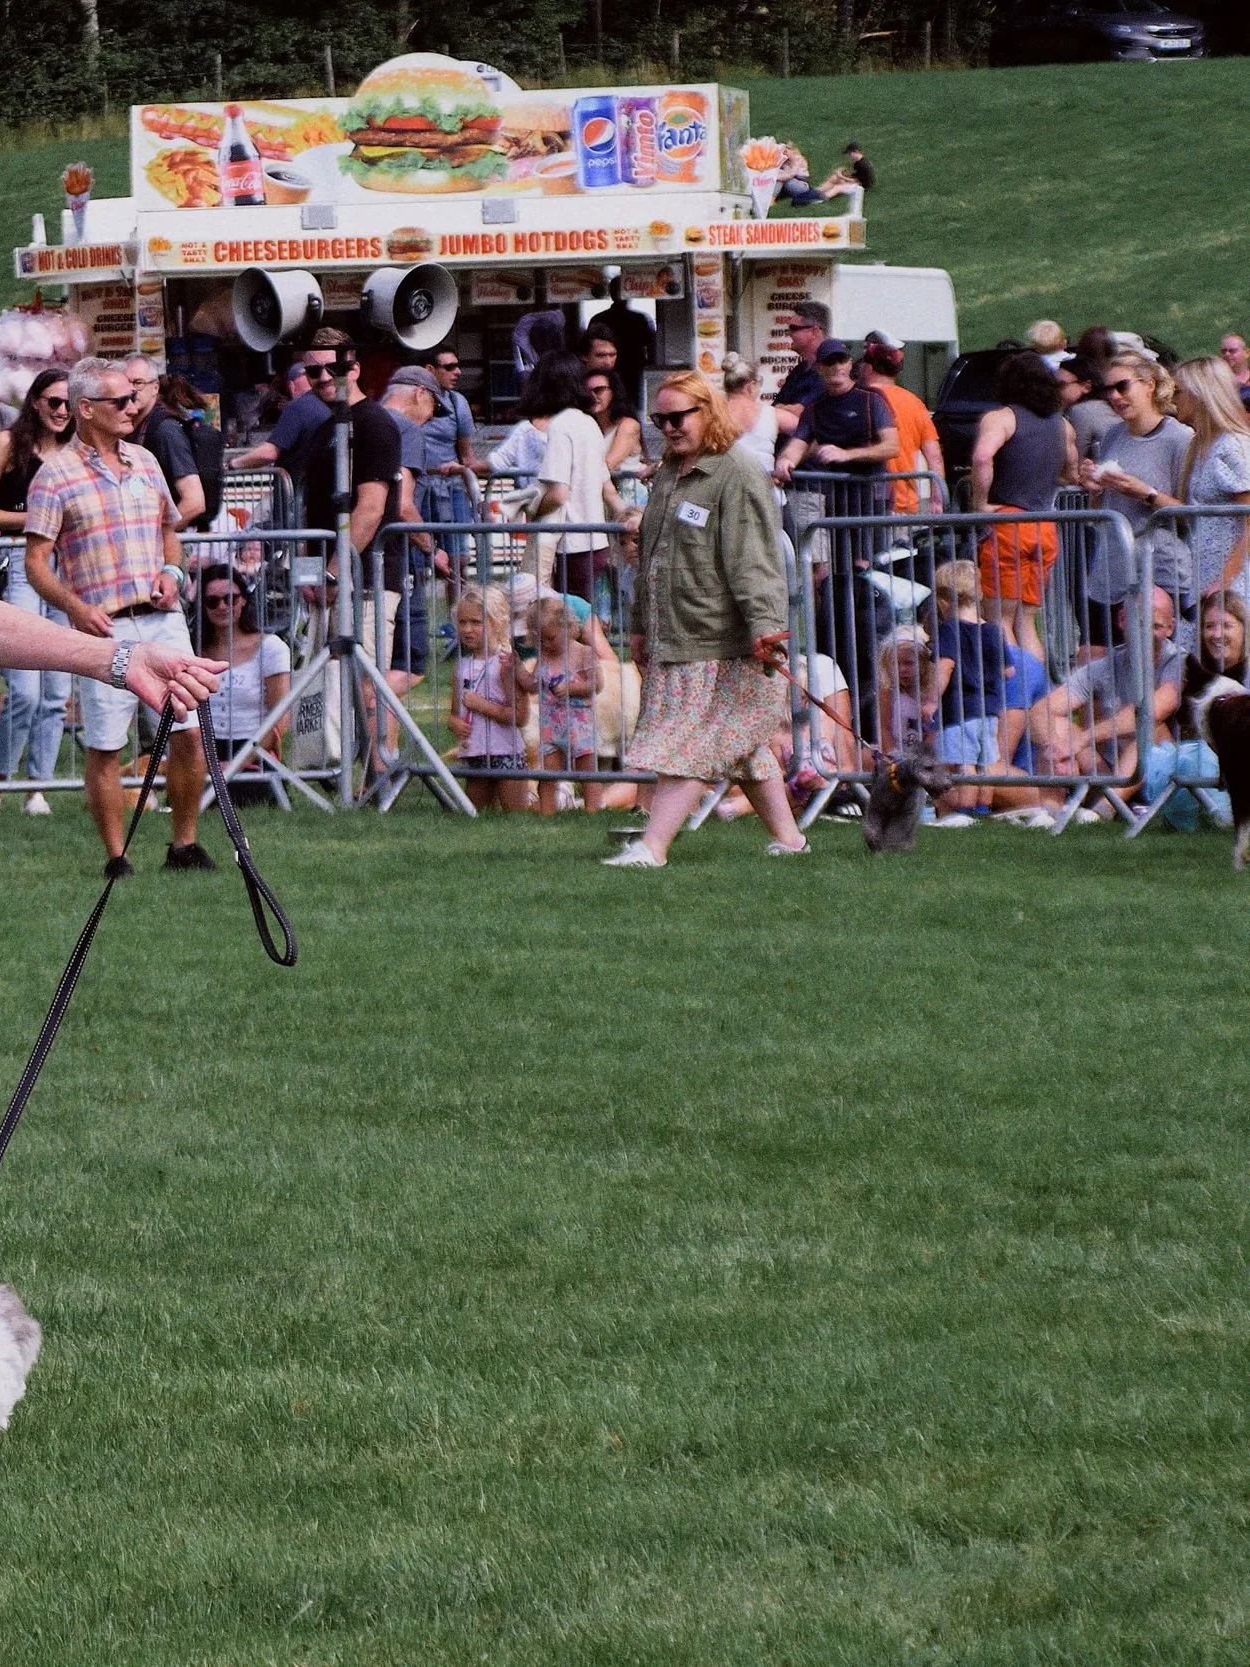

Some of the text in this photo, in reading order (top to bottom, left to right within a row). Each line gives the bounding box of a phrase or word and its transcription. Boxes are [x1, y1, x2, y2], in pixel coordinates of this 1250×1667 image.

[633, 110, 656, 177] Vimto
[439, 229, 609, 255] JUMBO HOTDOGS
[709, 222, 820, 246] STEAK SANDWICHES
[38, 250, 55, 272] HOT
[65, 247, 88, 270] COLD
[89, 245, 123, 268] DRINKS
[214, 237, 382, 262] CHEESEBURGERS
[770, 291, 812, 302] CHEESE
[687, 509, 700, 521] 30
